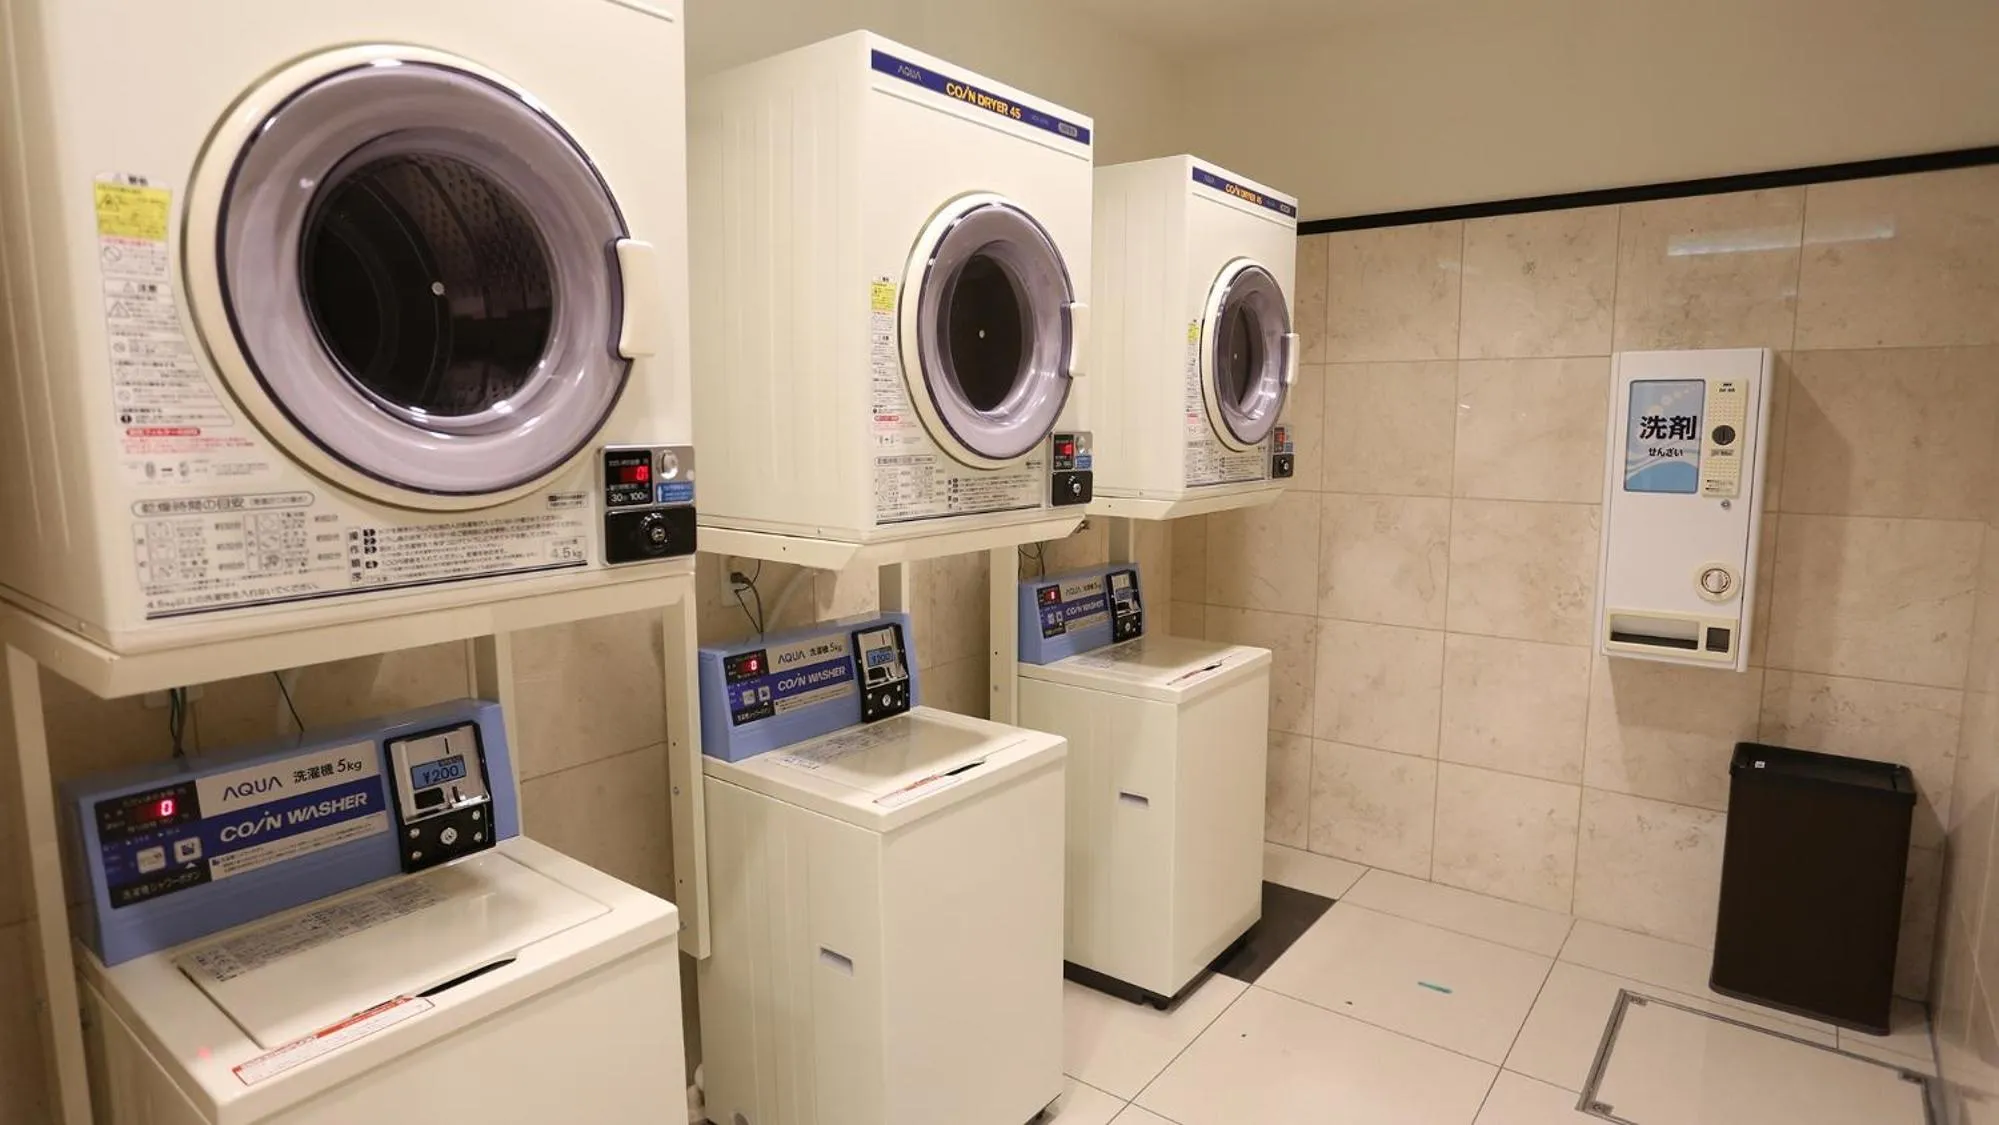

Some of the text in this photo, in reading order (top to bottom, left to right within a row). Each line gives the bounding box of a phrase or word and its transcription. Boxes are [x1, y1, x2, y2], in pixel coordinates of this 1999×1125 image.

[897, 64, 922, 81] AQUA
[977, 93, 1009, 115] DRYER
[1639, 415, 1697, 441] 洗剤
[1648, 447, 1683, 458] せんざい
[777, 650, 806, 665] AQUA
[808, 665, 846, 686] WASHER
[292, 758, 362, 784] 洗濯機 5kg
[422, 765, 459, 785] ¥200
[223, 776, 283, 802] AQUA
[160, 799, 173, 816] 0
[287, 791, 369, 825] WASHER
